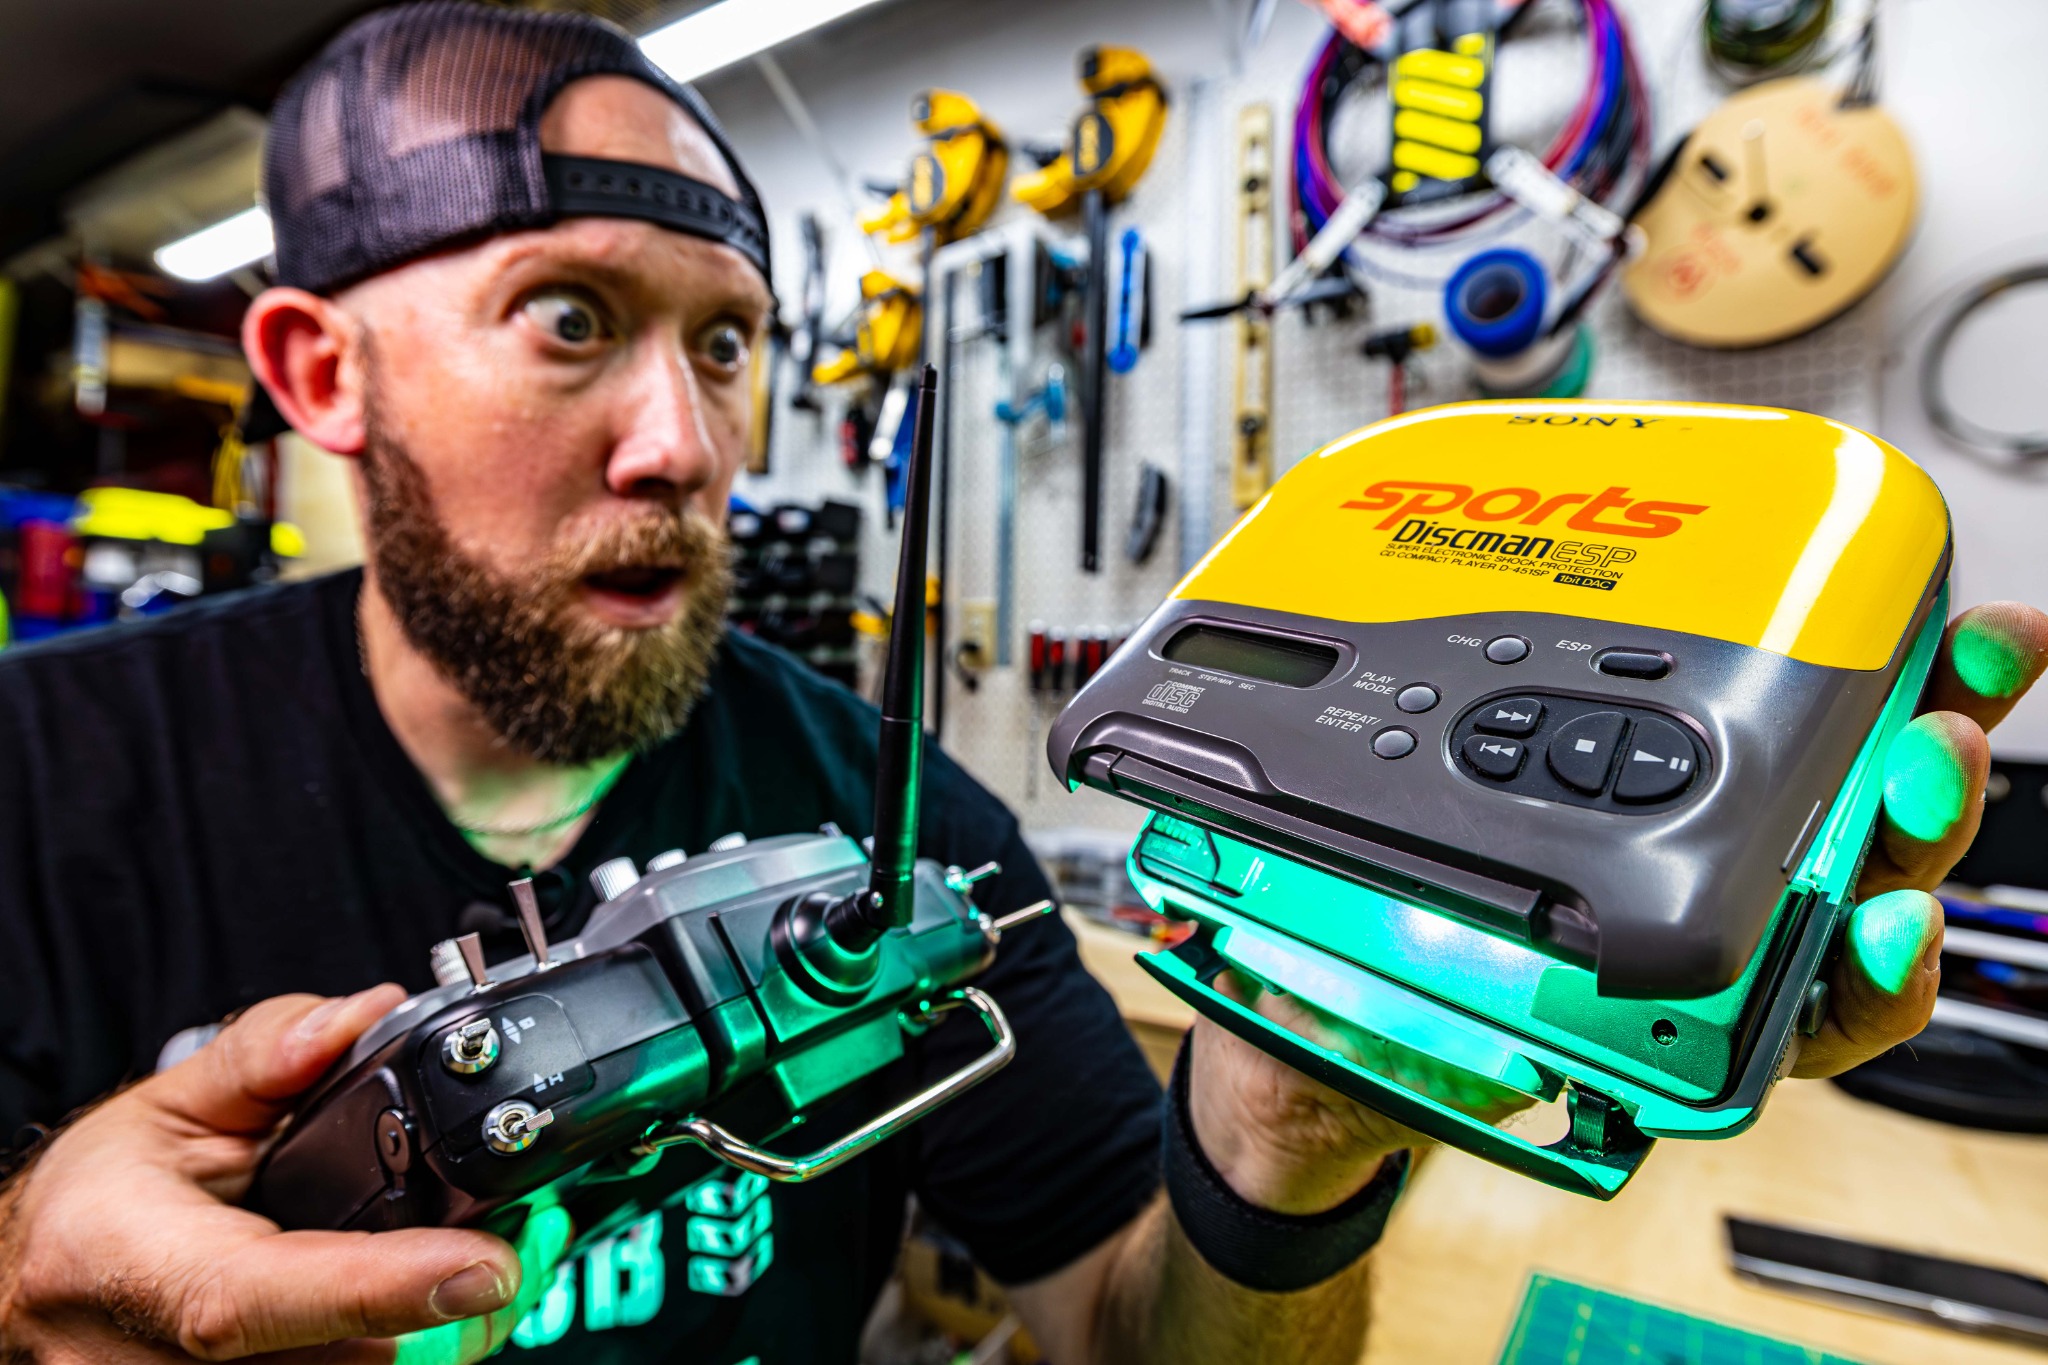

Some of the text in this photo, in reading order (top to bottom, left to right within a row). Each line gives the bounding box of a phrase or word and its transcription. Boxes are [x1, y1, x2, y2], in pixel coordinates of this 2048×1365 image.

[1507, 414, 1665, 428] SONY
[1339, 480, 1711, 538] sports
[1391, 519, 1637, 568] Discman ESP
[1379, 549, 1550, 577] CD COMPACT PLAYER D-451SP
[1385, 543, 1624, 579] SUPER ELECTRONIC SHOCK PROTECTION
[1559, 574, 1612, 589] 1bit DAC
[1446, 634, 1482, 648] CHG
[1555, 639, 1593, 653] ESP
[1168, 667, 1256, 691] TRACK STEP/MIN SEC
[1172, 681, 1206, 693] COMPACT
[1360, 671, 1397, 685] PLAY
[1146, 680, 1201, 708] disc
[1352, 679, 1397, 696] MODE
[1141, 698, 1189, 714] DIGITAL AUDIO
[1315, 714, 1363, 733] ENTER
[1323, 706, 1383, 726] REPEAT/
